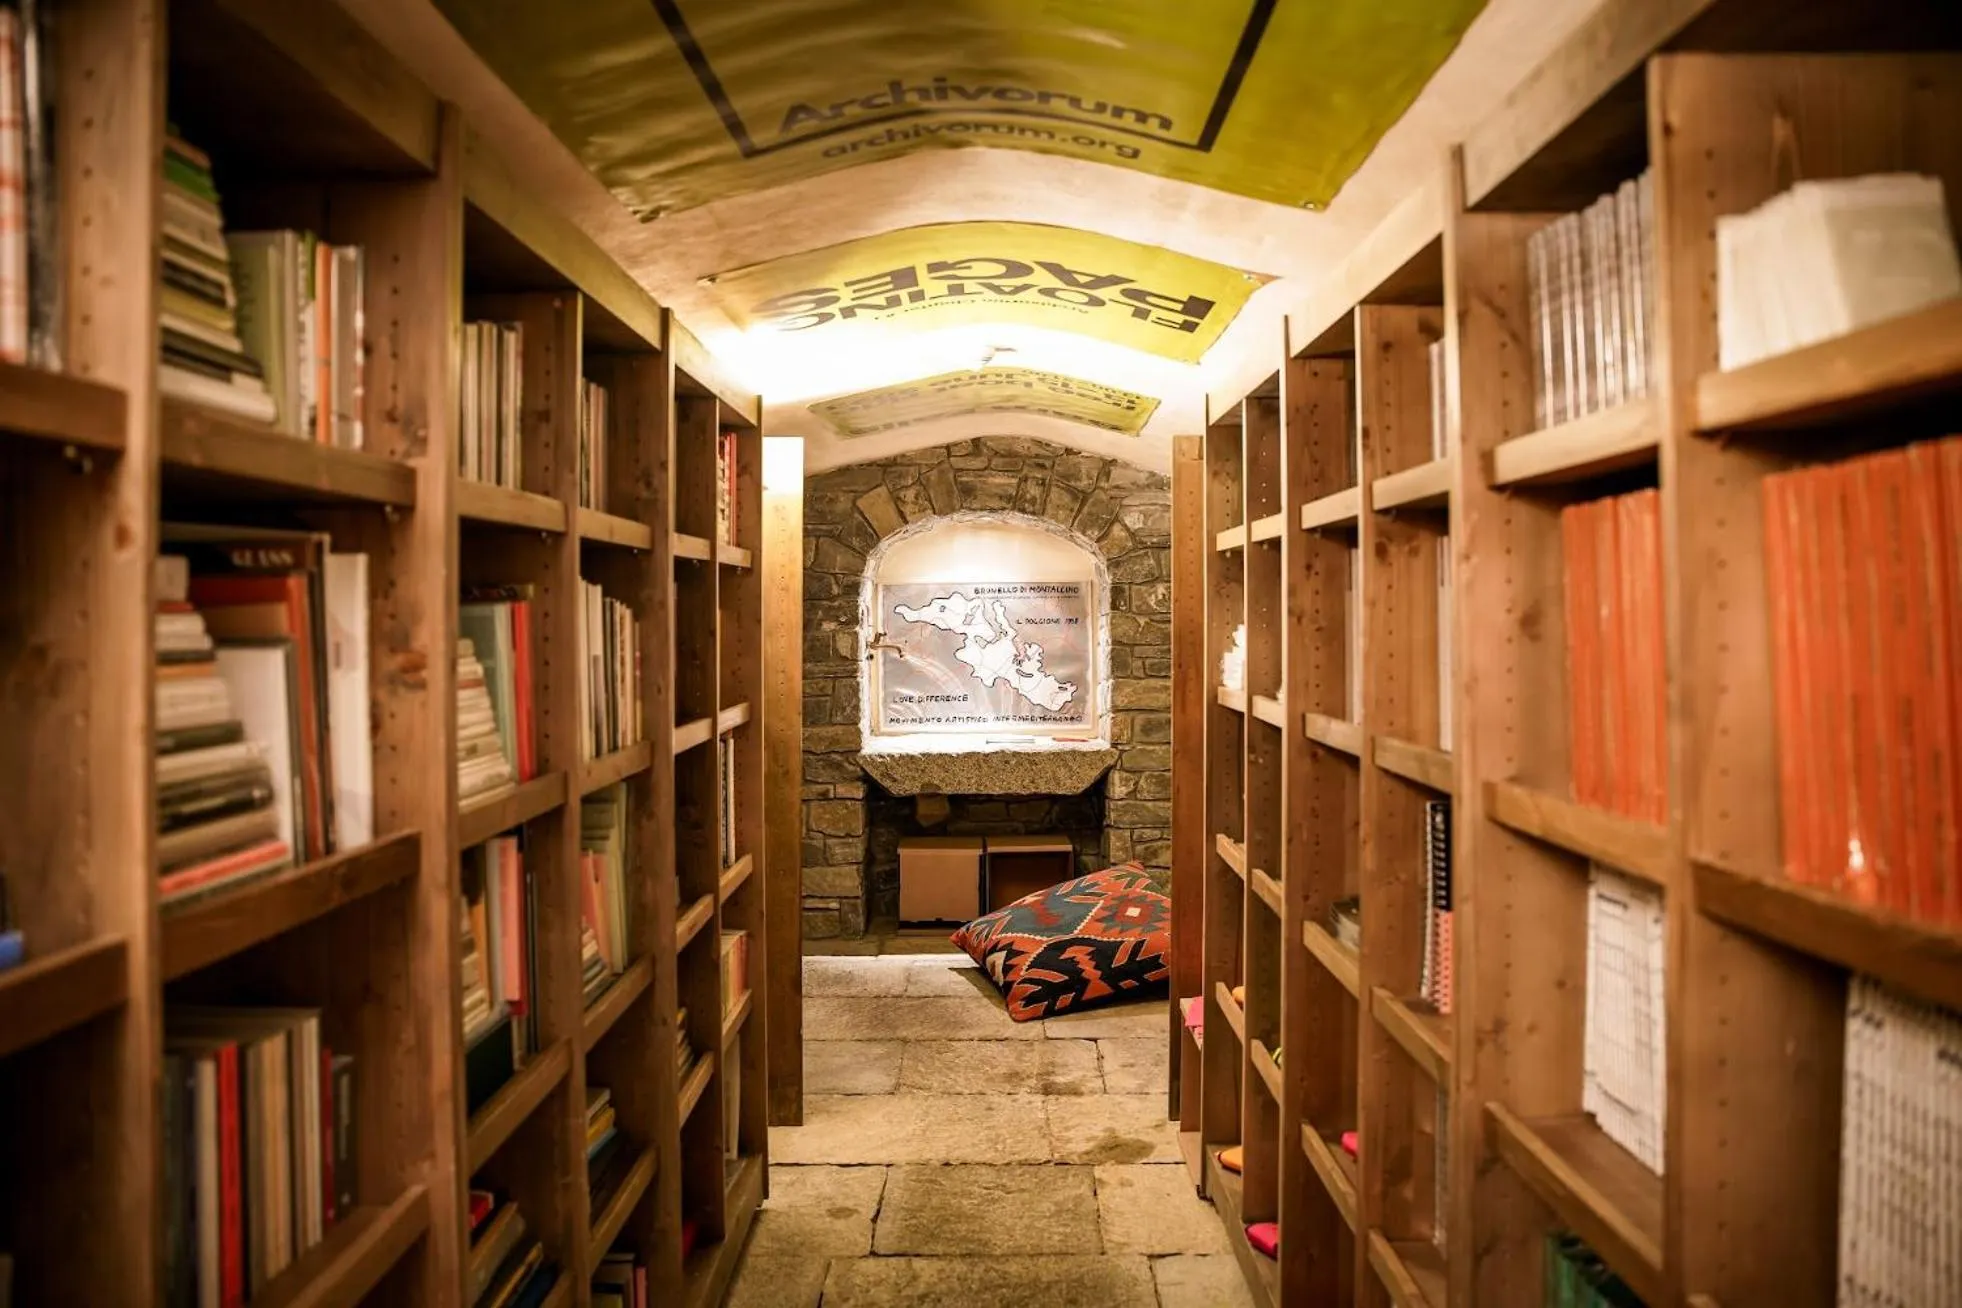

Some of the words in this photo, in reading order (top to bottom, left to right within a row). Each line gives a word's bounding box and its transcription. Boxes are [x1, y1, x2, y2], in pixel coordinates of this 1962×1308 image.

[779, 77, 1174, 134] Archivorum
[822, 121, 1142, 159] archivorum.org
[757, 258, 1217, 321] PAGES
[774, 281, 1203, 334] FLOATING
[974, 585, 1017, 595] BRUNELLO
[1019, 585, 1028, 594] DI
[1029, 585, 1079, 594] MONTALCINO
[892, 695, 914, 704] LOVE
[917, 694, 969, 704] DIFFERENCE
[889, 716, 942, 724] MOVIMENTO
[945, 716, 989, 724] ARTISTICO
